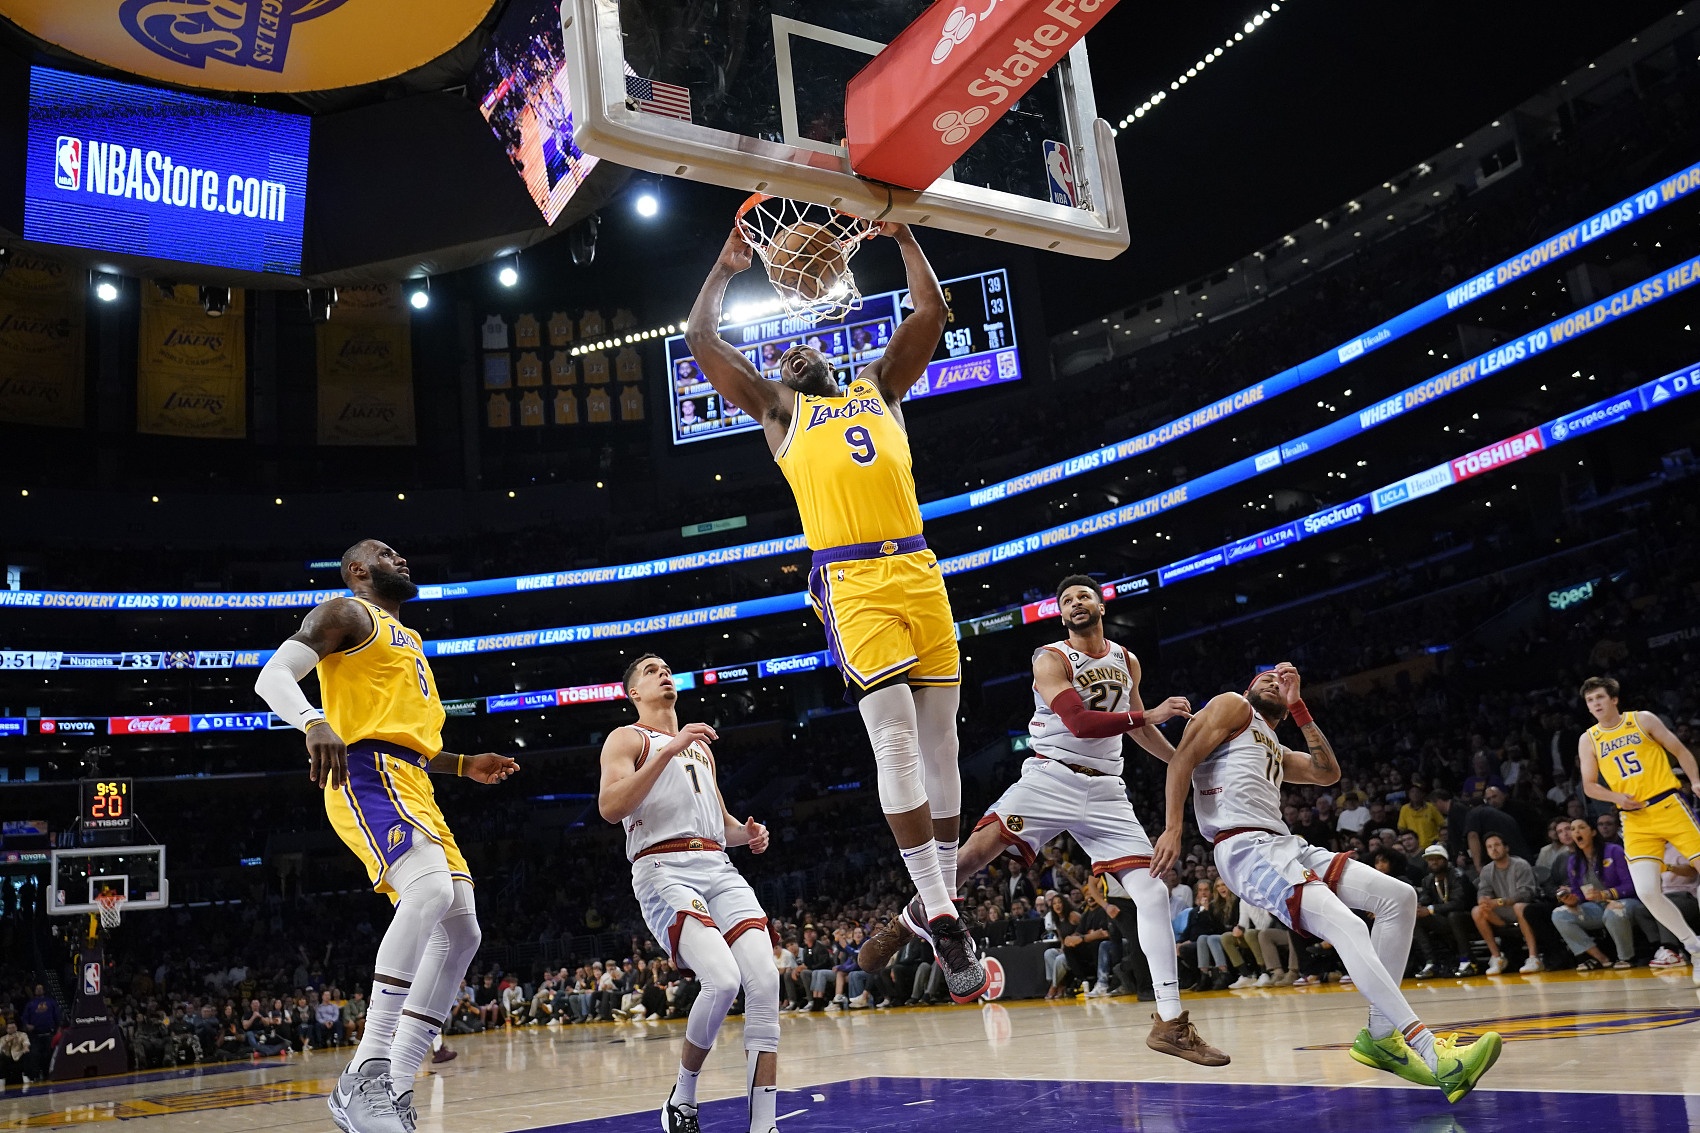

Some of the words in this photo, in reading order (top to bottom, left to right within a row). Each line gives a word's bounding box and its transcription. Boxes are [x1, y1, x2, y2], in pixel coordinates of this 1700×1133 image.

[86, 140, 286, 222] NBAStore.com
[1054, 192, 1068, 205] NBA
[1446, 271, 1495, 309] WHERE
[1497, 228, 1580, 285] DISCOVERY
[1581, 202, 1634, 242] LEADS
[1635, 189, 1658, 214] TO
[988, 277, 1001, 293] 39
[991, 299, 1005, 314] 33
[743, 325, 759, 342] ON
[761, 320, 780, 338] THE
[782, 314, 818, 334] COURT
[878, 324, 886, 337] 3
[945, 328, 972, 350] 9:51
[163, 328, 223, 352] LAKERS
[834, 333, 841, 346] 5
[1360, 395, 1403, 428] WHERE
[1405, 361, 1478, 409] DISCOVERY
[1480, 340, 1526, 375] LEADS
[1527, 330, 1548, 354] TO
[1550, 278, 1664, 343] WORLD-CLASS
[838, 372, 846, 385] 2
[934, 363, 994, 389] LAKERS
[163, 391, 223, 414] LAKERS
[707, 397, 715, 410] 5
[806, 398, 884, 431] LAKERS
[1568, 399, 1632, 430] crypto.com
[844, 425, 878, 467] 9
[970, 484, 1005, 506] WHERE
[1006, 464, 1064, 495] DISCOVERY
[1064, 452, 1099, 476] LEADS
[1101, 448, 1116, 464] TO
[1117, 417, 1191, 458] WORLD-CLASS
[1192, 400, 1233, 428] HEALTH
[1234, 385, 1264, 410] CARE
[1454, 434, 1539, 477] TOSHIBA
[1380, 488, 1406, 503] UCLA
[1410, 472, 1447, 493] Health
[1304, 503, 1363, 533] Spectrum
[940, 551, 991, 575] ISCOVERY
[992, 538, 1024, 561] LEADS
[1026, 535, 1040, 551] TO
[1041, 512, 1116, 547] WORLD-CLASS
[1118, 500, 1160, 523] HEALTH
[1160, 486, 1188, 508] CARE
[1263, 528, 1294, 546] ULTRA
[516, 575, 554, 590] WHERE
[556, 569, 616, 585] DISCOVERY
[618, 564, 653, 579] LEADS
[654, 560, 667, 574] TO
[668, 547, 742, 571] WORLD-CLASS
[743, 539, 784, 558] HEALTH
[785, 536, 807, 551] CAR
[1163, 564, 1194, 579] AMERICAN
[1116, 578, 1149, 594] TOYOTA
[43, 594, 116, 608] DISCOVERY
[118, 595, 159, 608] LEADS
[162, 595, 178, 607] TO
[180, 594, 265, 608] WORLD-CLASS
[268, 593, 313, 606] HEALTH
[437, 640, 476, 654] WHERE
[477, 633, 538, 650] DISCOVERY
[539, 628, 574, 643] LEADS
[576, 627, 590, 640] TO
[592, 616, 666, 638] WORLD-CLASS
[668, 609, 708, 628] HEALTH
[709, 606, 737, 621] CARE
[50, 658, 57, 667] 2
[70, 656, 113, 667] Nuggets
[131, 654, 152, 666] 33
[235, 653, 260, 665] ARE
[766, 655, 818, 674] Spectrum
[415, 657, 429, 699] 6
[718, 668, 748, 680] TOYOTA
[1076, 667, 1128, 689] DENVER
[525, 694, 554, 704] ULTRA
[560, 685, 625, 703] TOSHIBA
[1089, 683, 1122, 712] 27
[58, 722, 95, 730] TOYOTA
[214, 716, 263, 728] DELTA
[1600, 732, 1642, 758] LAKERS
[1614, 750, 1644, 779] 15
[97, 782, 126, 796] 9:51
[684, 764, 702, 793] 1
[1200, 786, 1223, 796] NUGGETS
[92, 795, 122, 818] 20
[97, 818, 130, 827] TISSOT
